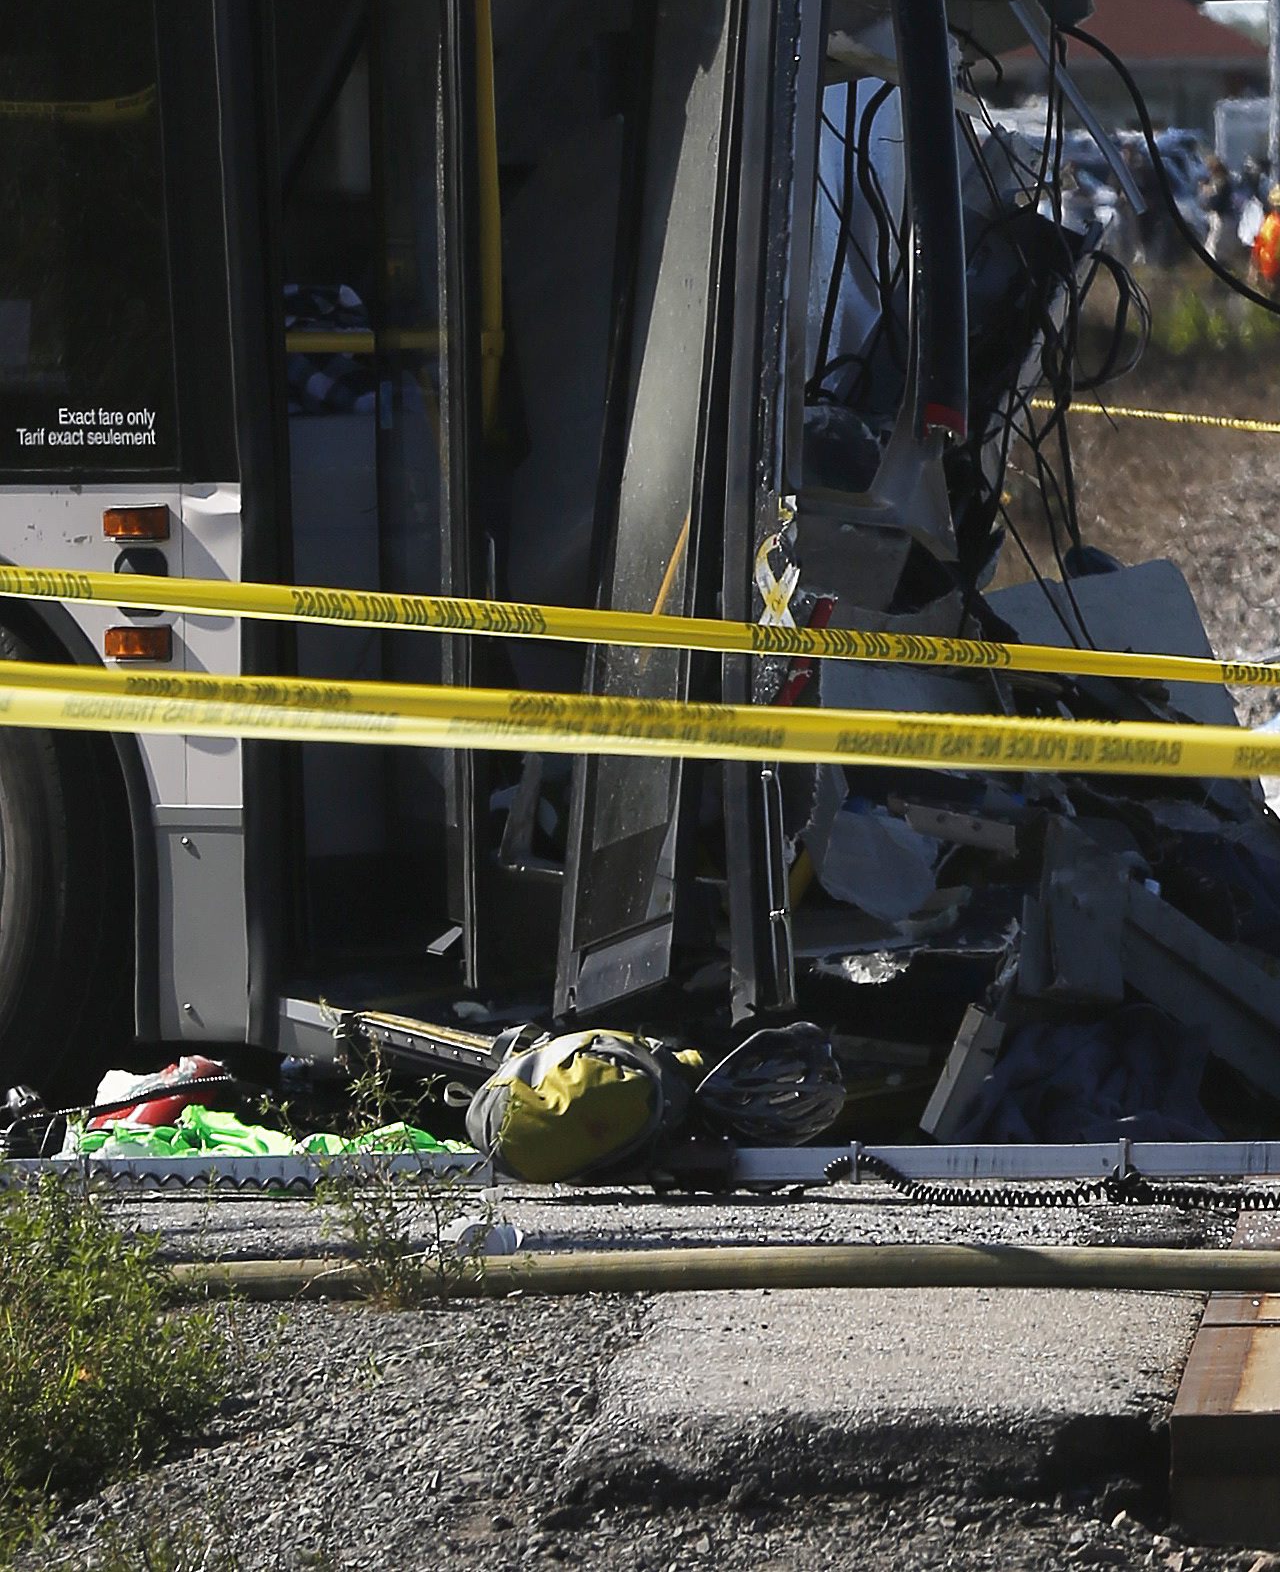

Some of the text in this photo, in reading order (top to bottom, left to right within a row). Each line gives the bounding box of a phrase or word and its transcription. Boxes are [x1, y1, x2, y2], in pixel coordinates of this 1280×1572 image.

[58, 407, 156, 429] Exact fare only
[16, 428, 156, 445] Tarif exact seulement
